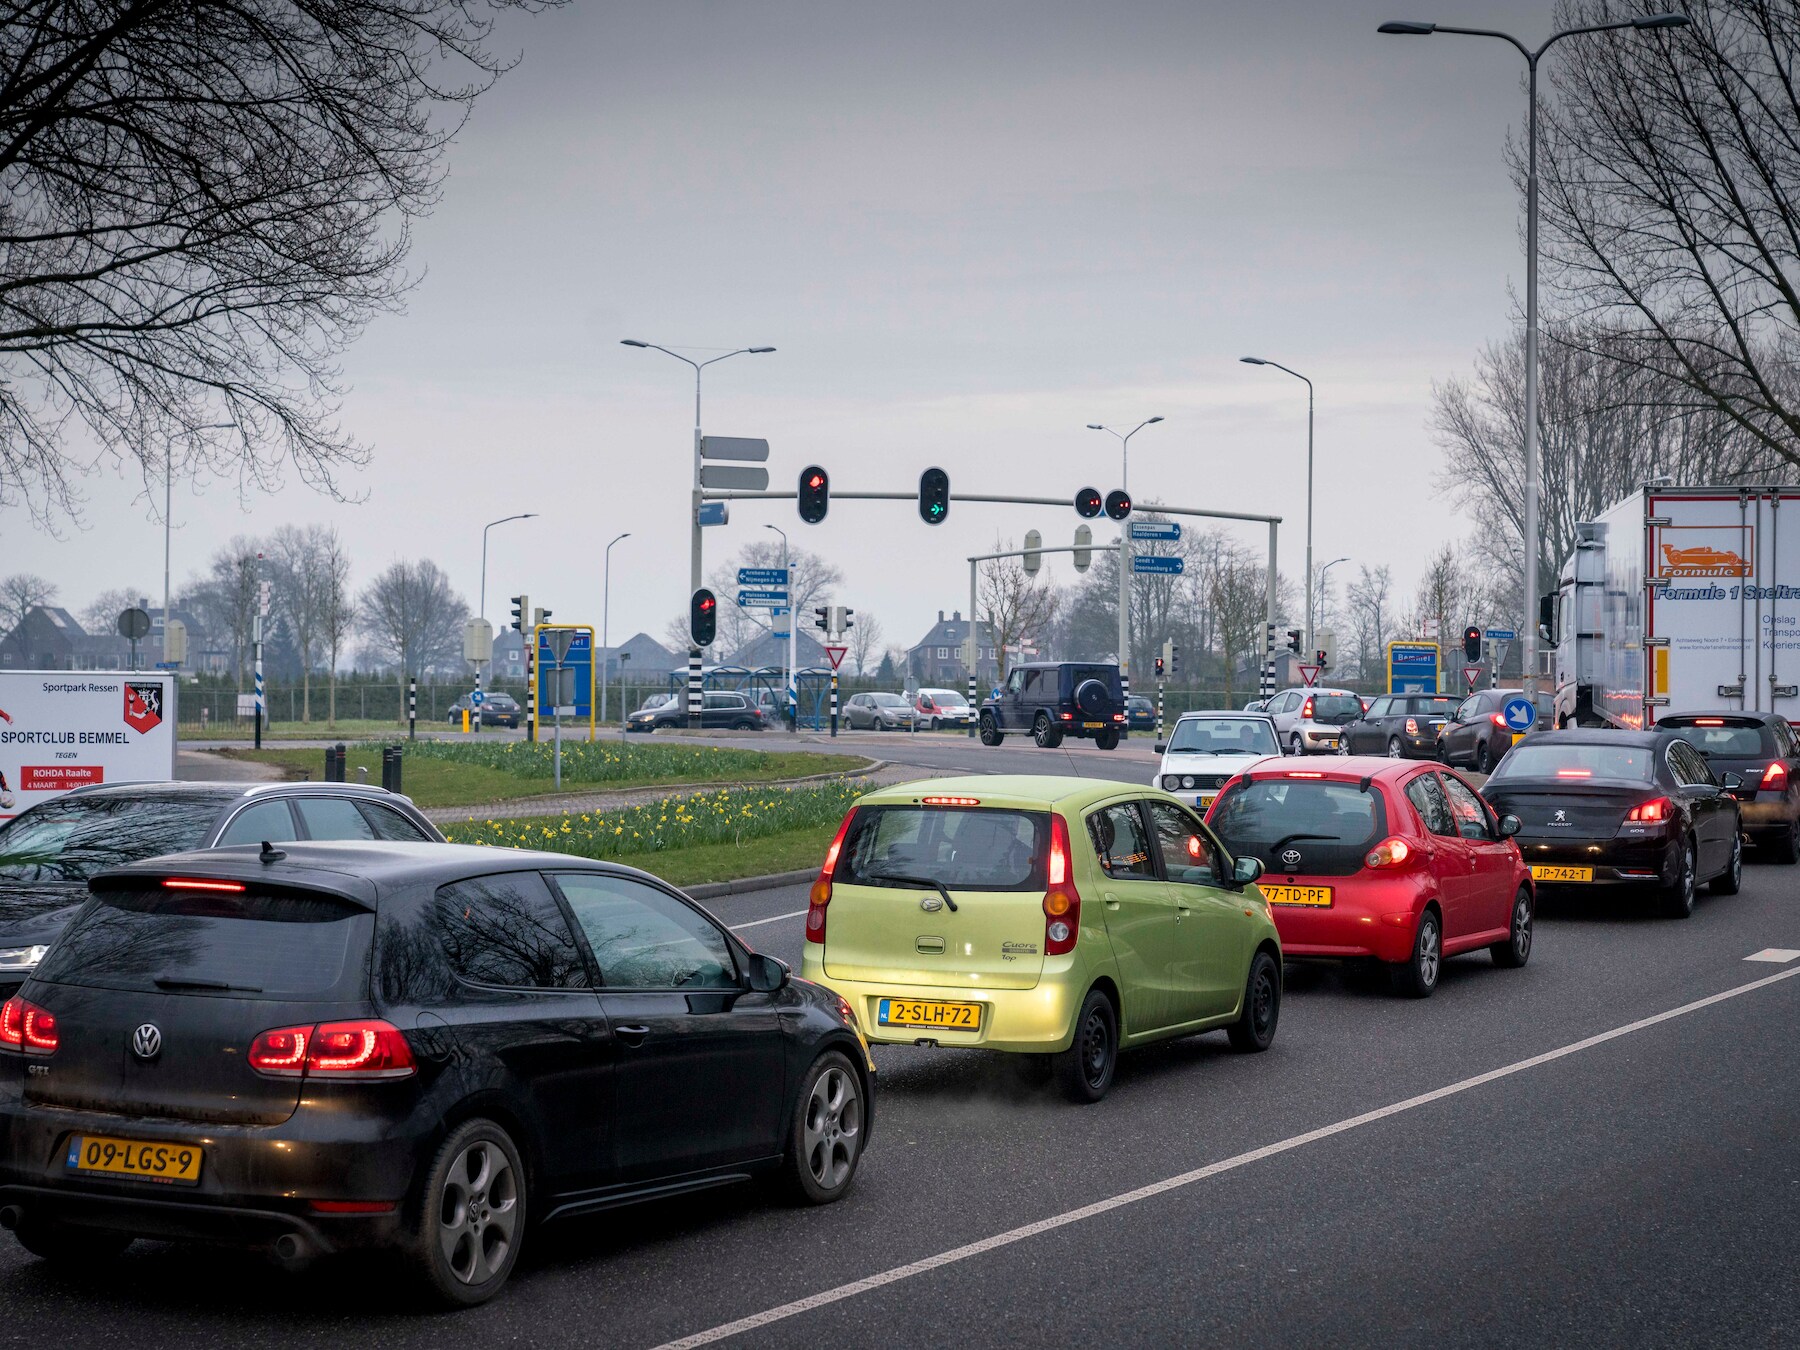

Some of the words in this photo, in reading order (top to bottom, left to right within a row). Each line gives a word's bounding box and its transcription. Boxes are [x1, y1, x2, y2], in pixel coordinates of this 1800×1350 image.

[1661, 566, 1735, 576] Formule
[1743, 567, 1751, 576] 1
[1654, 585, 1727, 600] Formule
[1730, 586, 1740, 600] 1
[1762, 615, 1796, 626] Opslag
[1397, 653, 1431, 662] Bemmel
[42, 683, 86, 694] Sportpark
[88, 683, 119, 693] Ressen
[1, 732, 75, 744] SPORTCLUB
[79, 732, 130, 744] BEMMEL
[33, 769, 63, 778] ROHDA
[66, 768, 92, 777] Raalte
[1536, 868, 1586, 880] JP-742-T
[1263, 887, 1325, 902] 77-TD-PF
[1002, 941, 1037, 949] Cuore
[895, 1004, 972, 1024] 2-SLH-72
[28, 1065, 50, 1076] GTI
[68, 1154, 78, 1163] NL
[86, 1142, 193, 1174] 09-LGS-9
